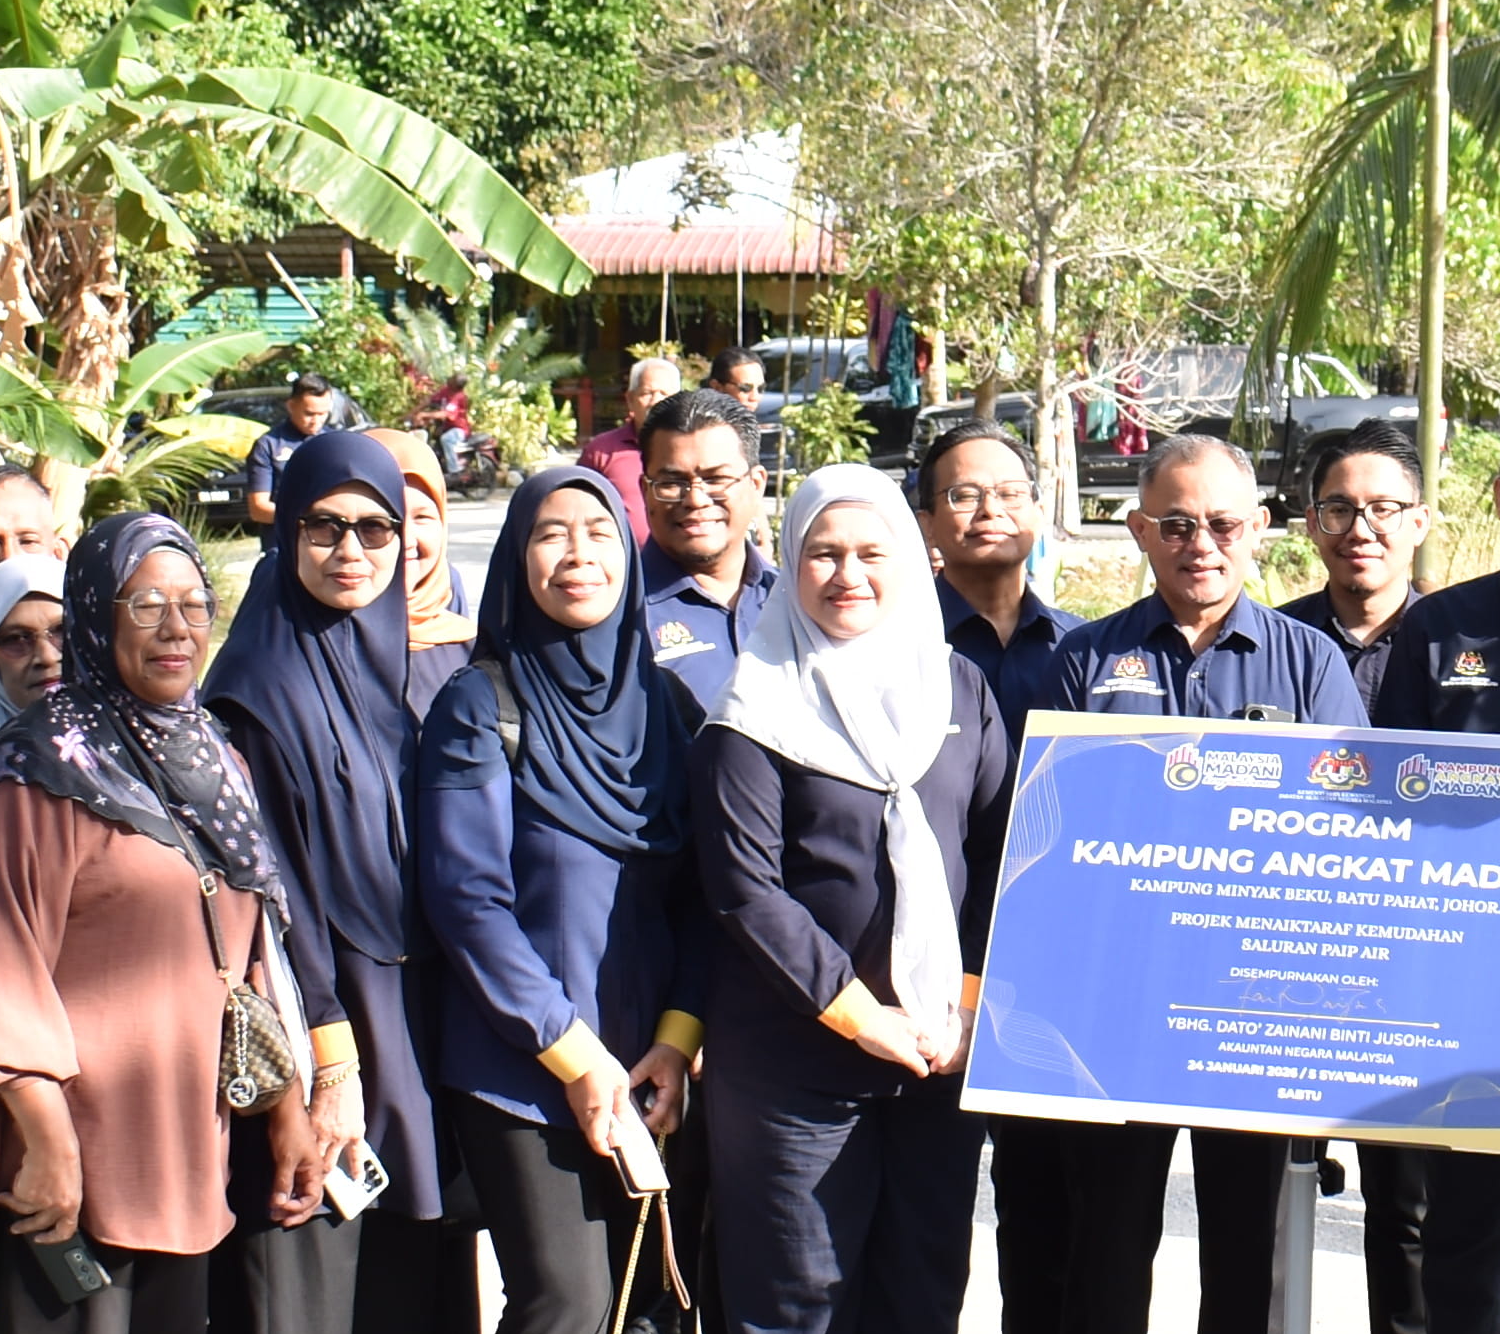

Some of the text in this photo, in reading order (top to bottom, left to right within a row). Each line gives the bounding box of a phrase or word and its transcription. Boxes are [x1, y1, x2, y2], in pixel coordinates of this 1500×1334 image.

[1205, 763, 1279, 777] MADANI
[1207, 753, 1279, 764] MALAYSIA
[1229, 807, 1412, 841] PROGRAM
[1072, 839, 1255, 874] KAMPUNG
[1261, 851, 1414, 883] ANGKAT
[1130, 878, 1213, 896] KAMPUNG
[1216, 883, 1281, 900] MINYAK
[1284, 888, 1332, 904] BEKU,
[1336, 891, 1381, 907] BATU
[1383, 894, 1440, 911] PAHAT,
[1170, 912, 1464, 944] PROJEK MENAIKTARAF KEMUDAHAN
[1241, 938, 1390, 960] SALURAN PAIP AIR
[1230, 967, 1379, 987] DISEMPURNAKAN OLEH:
[1167, 1017, 1212, 1032] YBHG.
[1265, 1024, 1326, 1040] ZAINANI
[1330, 1029, 1370, 1043] BINTI
[1218, 1041, 1394, 1065] AKAUNTAN NEGARA MALAYSIA
[1206, 1061, 1264, 1076] JANUARI
[1277, 1087, 1322, 1101] SABTU
